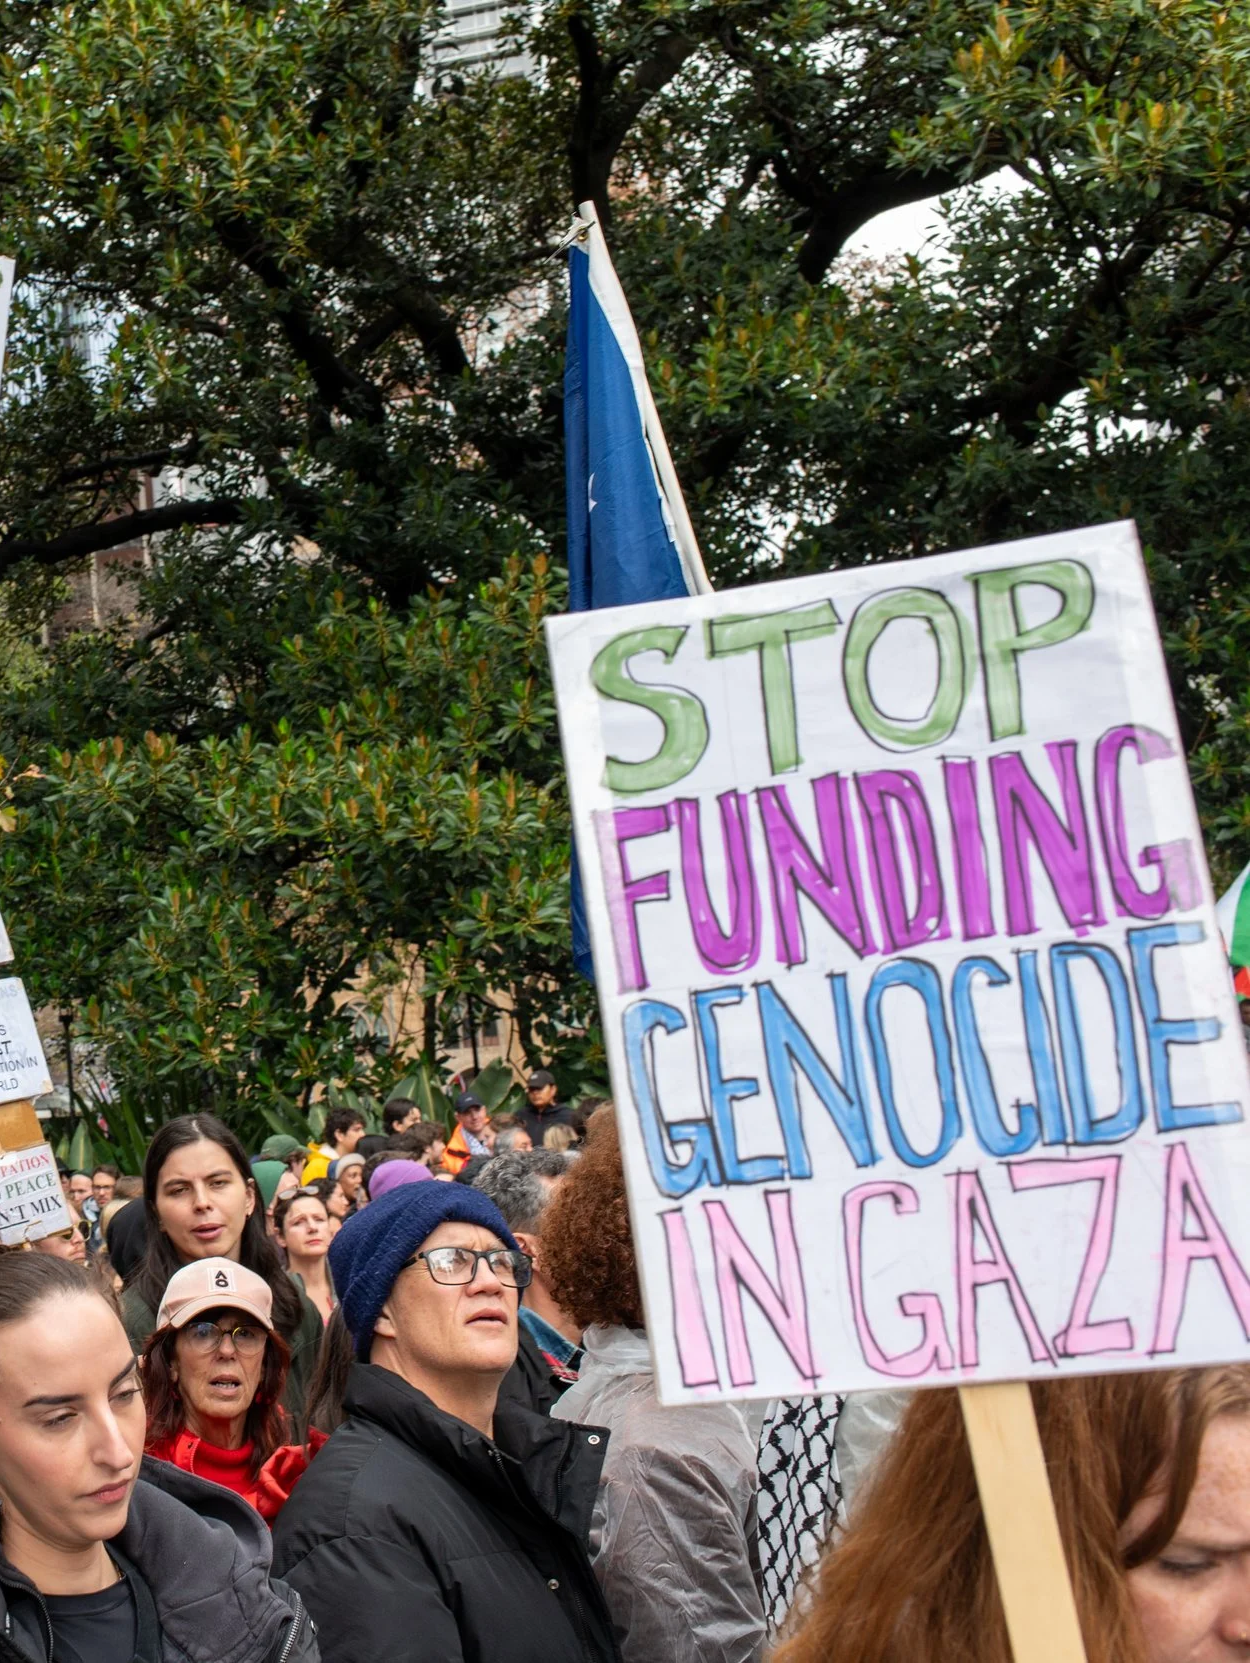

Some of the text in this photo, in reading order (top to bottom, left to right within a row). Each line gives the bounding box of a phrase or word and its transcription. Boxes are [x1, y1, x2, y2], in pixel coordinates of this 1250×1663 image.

[589, 558, 1095, 797] STOP
[593, 724, 1204, 994] FUNDING
[27, 1056, 39, 1069] IN
[621, 921, 1245, 1199] GENOCIDE
[5, 1172, 57, 1200] PEACE
[30, 1194, 63, 1217] MIX
[655, 1142, 1250, 1390] IN GAZA
